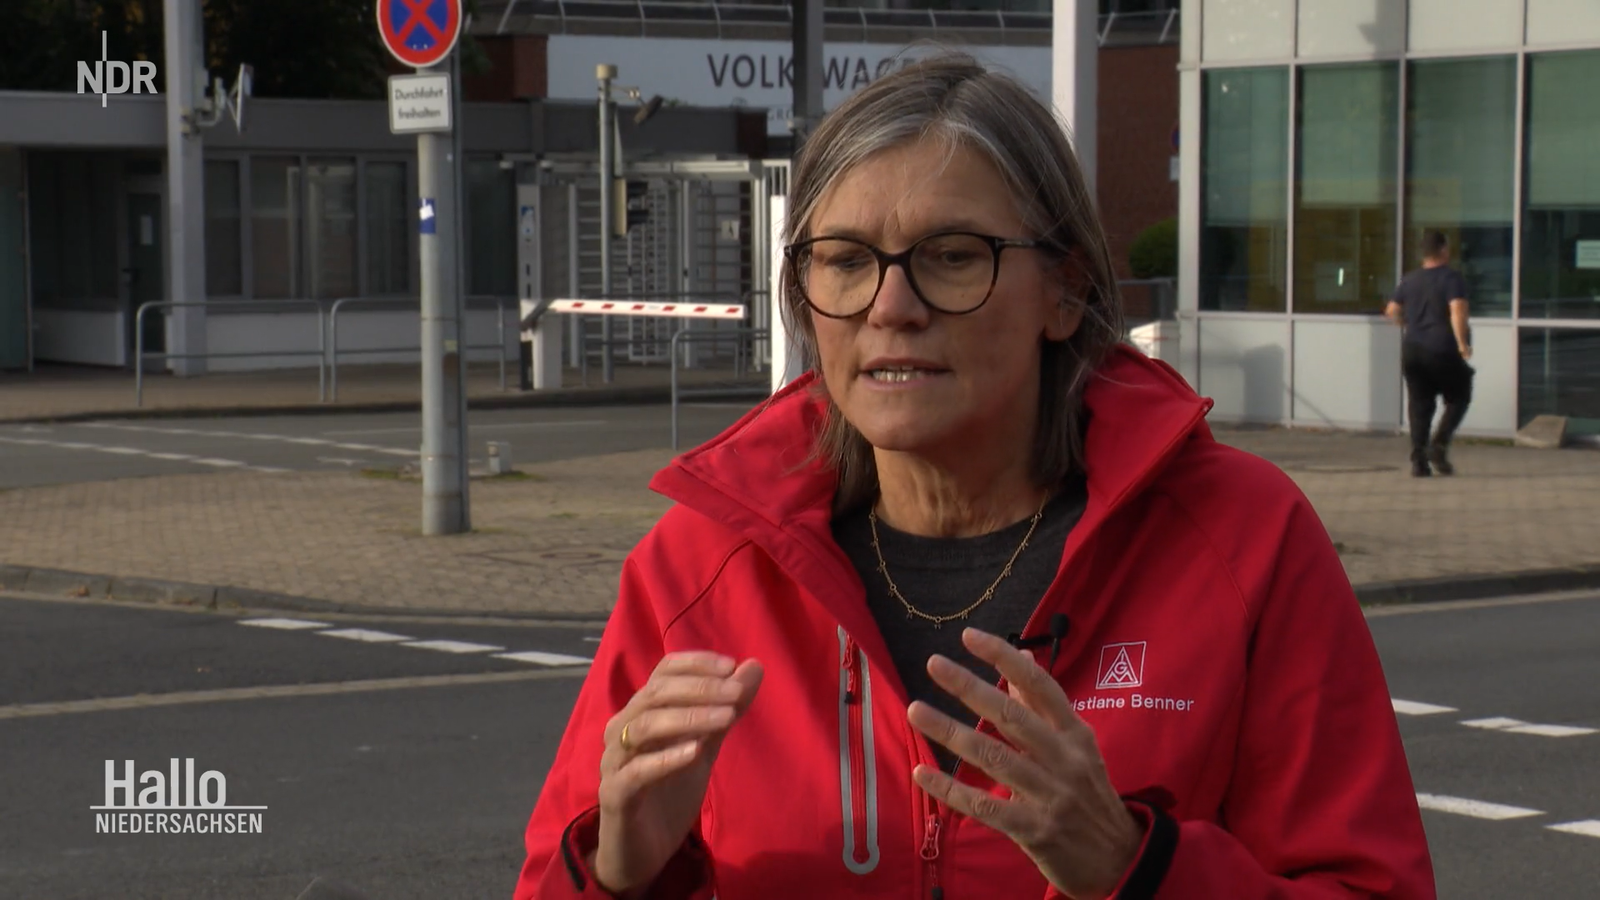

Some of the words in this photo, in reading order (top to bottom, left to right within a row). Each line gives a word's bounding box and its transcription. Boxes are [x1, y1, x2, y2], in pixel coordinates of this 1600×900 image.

[395, 87, 443, 100] Durchfahrt
[398, 106, 441, 119] freihalten
[1131, 693, 1194, 711] Benner
